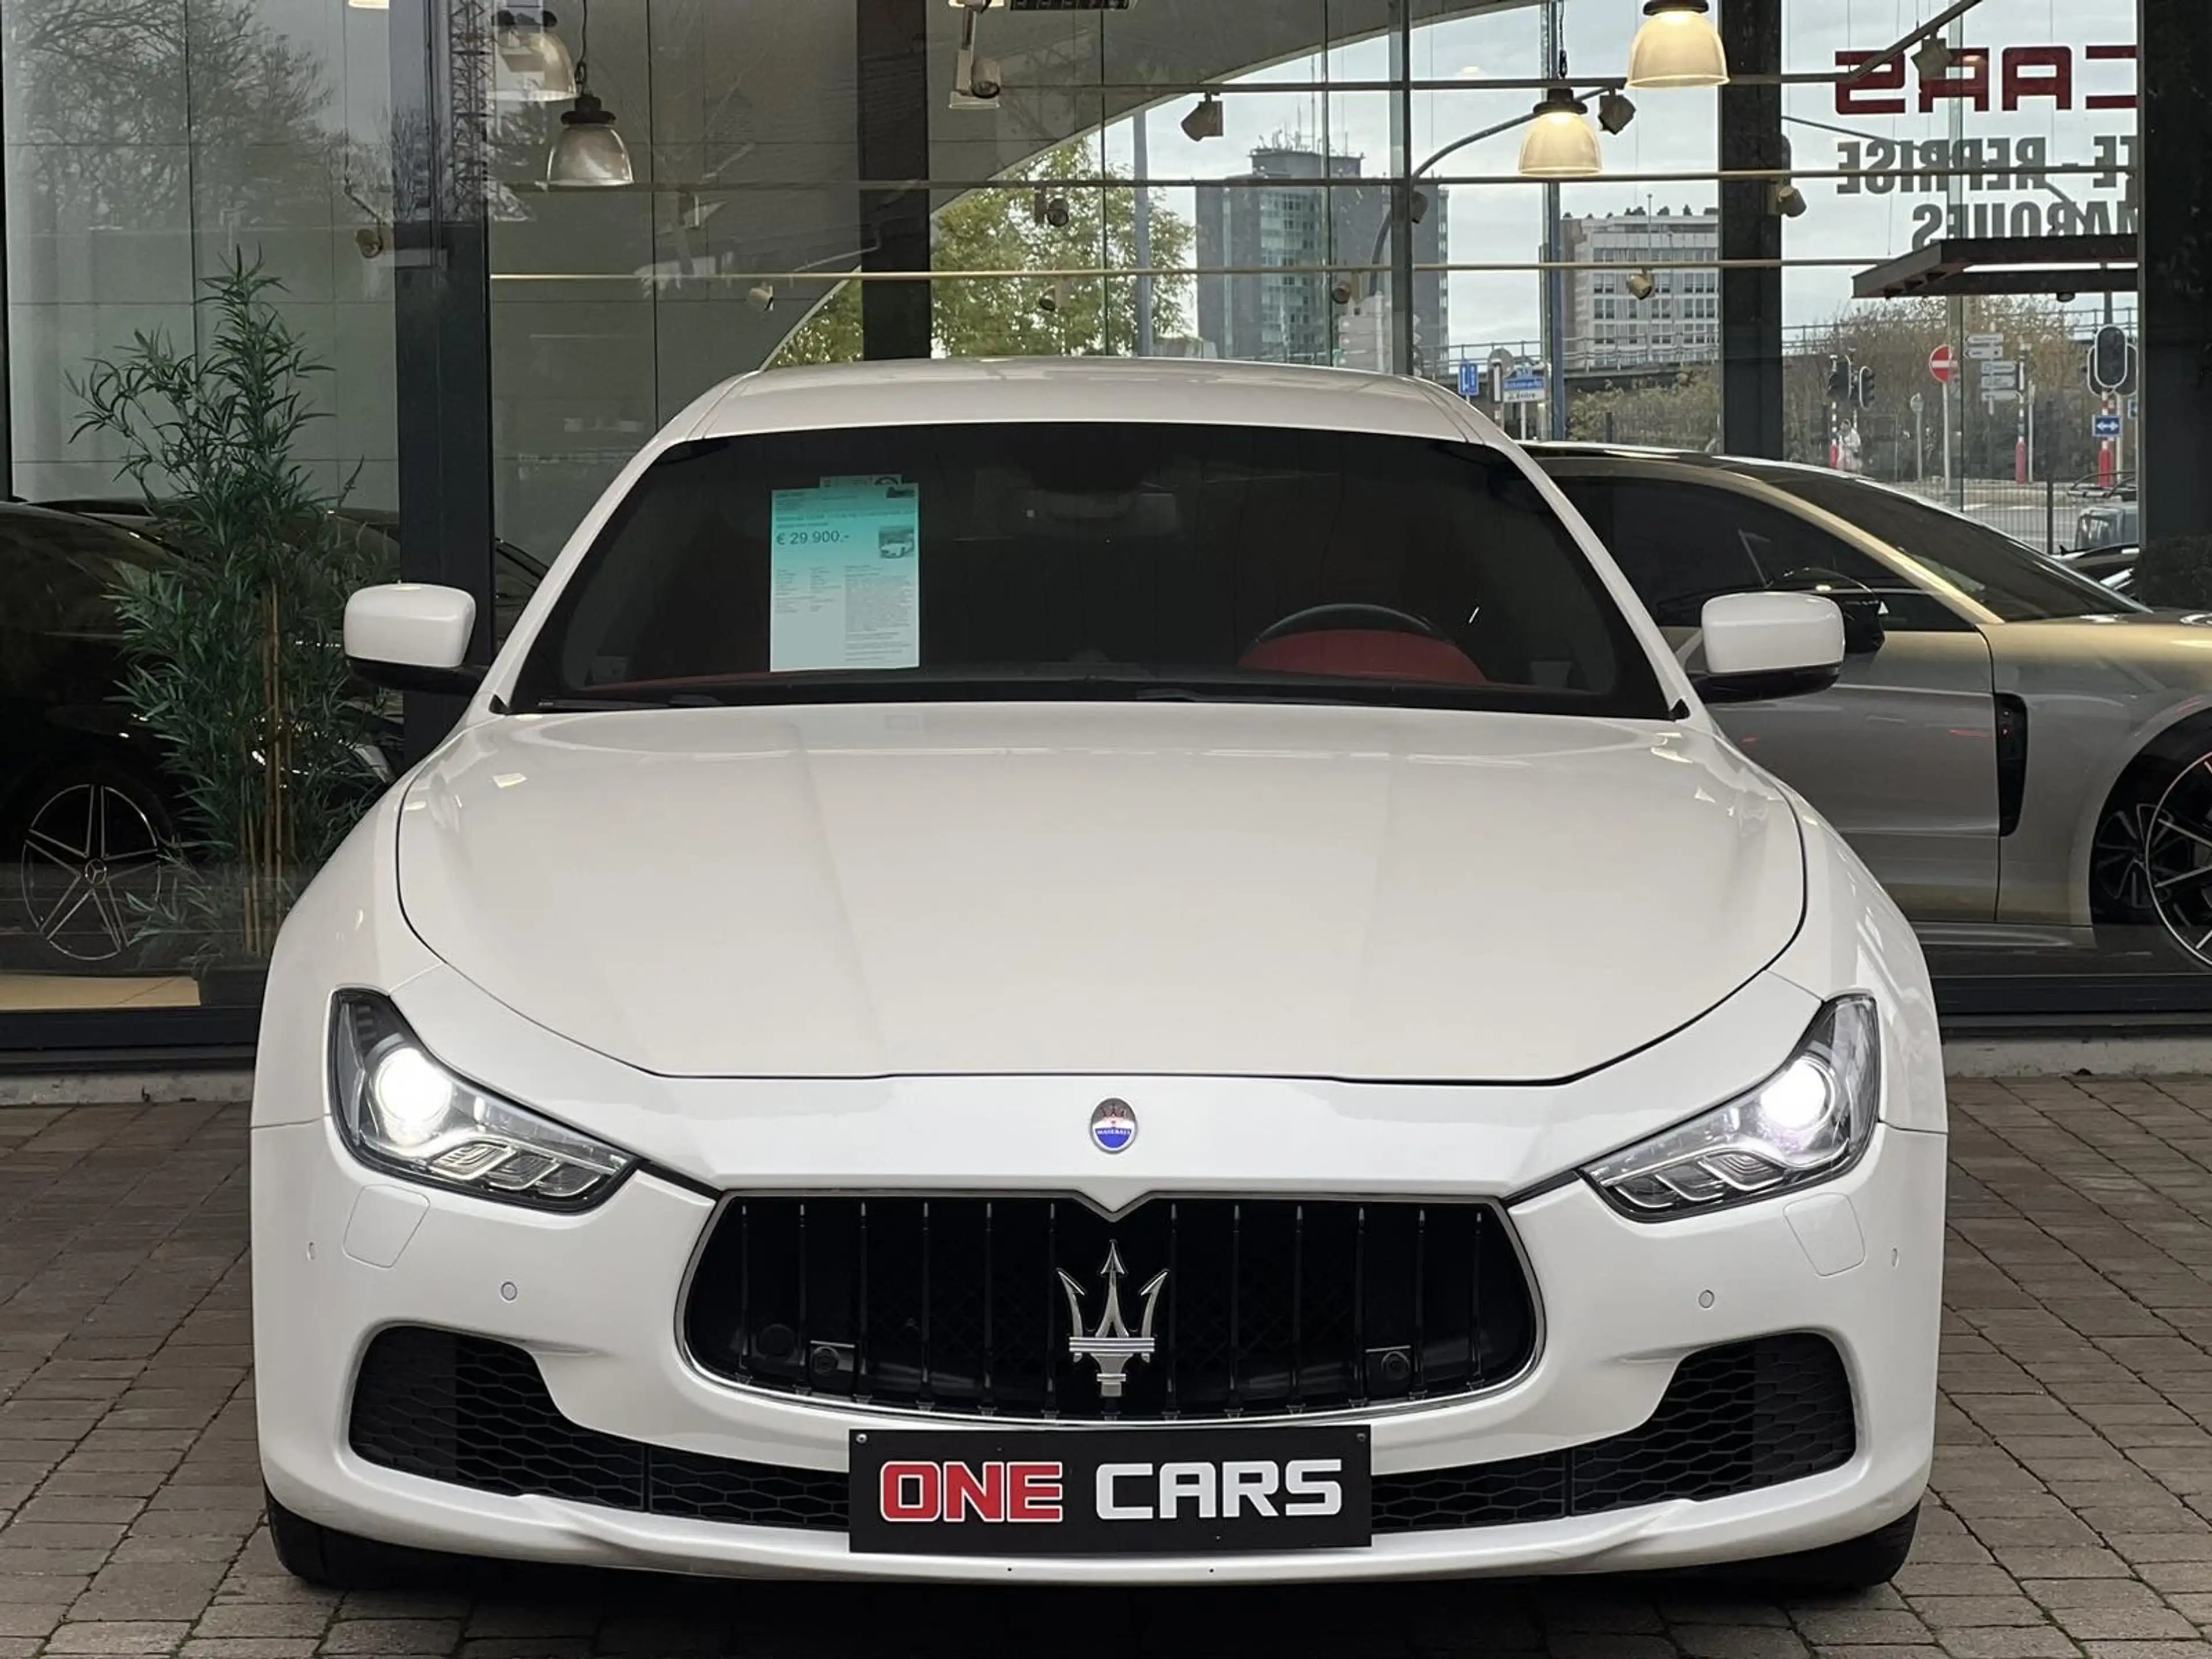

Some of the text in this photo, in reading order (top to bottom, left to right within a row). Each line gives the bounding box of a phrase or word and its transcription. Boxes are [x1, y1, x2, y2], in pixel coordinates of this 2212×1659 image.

[777, 532, 785, 545] €
[880, 1458, 1343, 1522] ONE CARS
